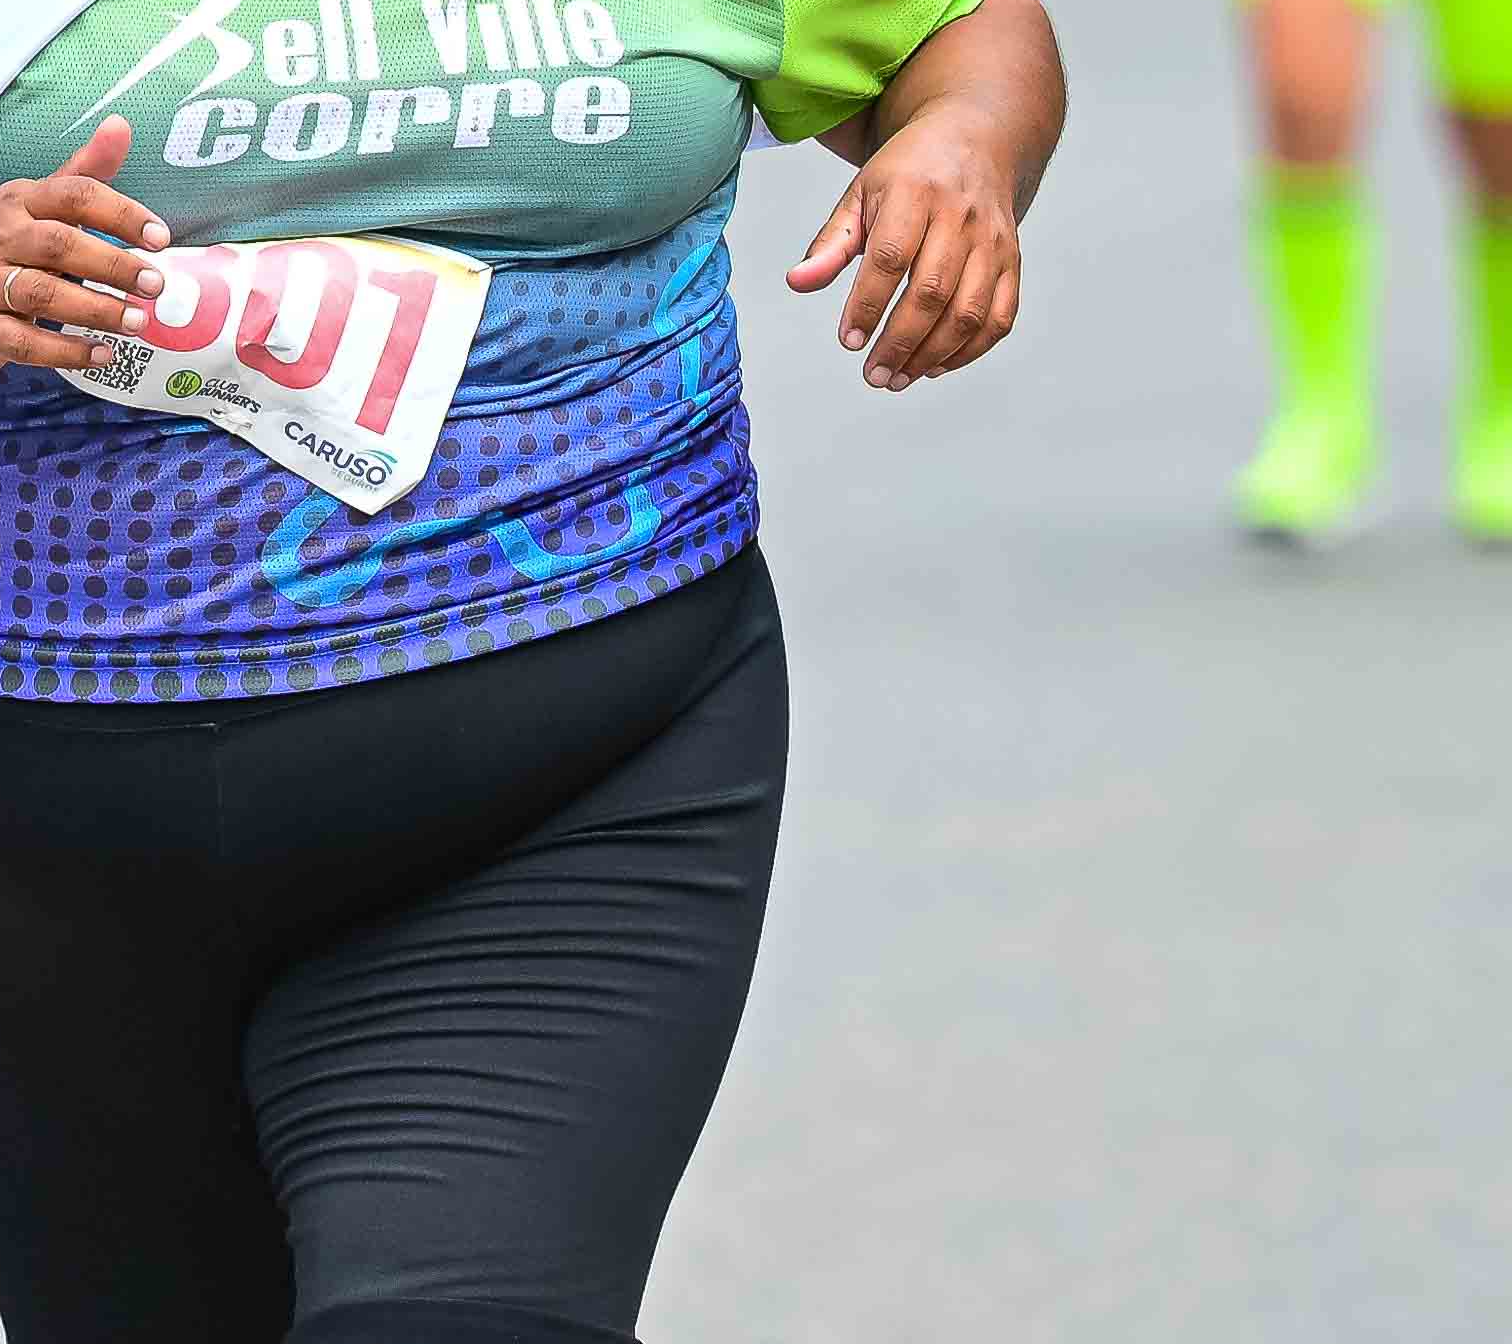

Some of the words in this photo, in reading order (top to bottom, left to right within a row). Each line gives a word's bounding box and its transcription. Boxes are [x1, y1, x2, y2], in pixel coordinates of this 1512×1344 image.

[162, 76, 632, 167] corre
[196, 387, 261, 413] RUNNER'S
[205, 378, 239, 393] CLUB
[284, 421, 387, 485] CARUSO
